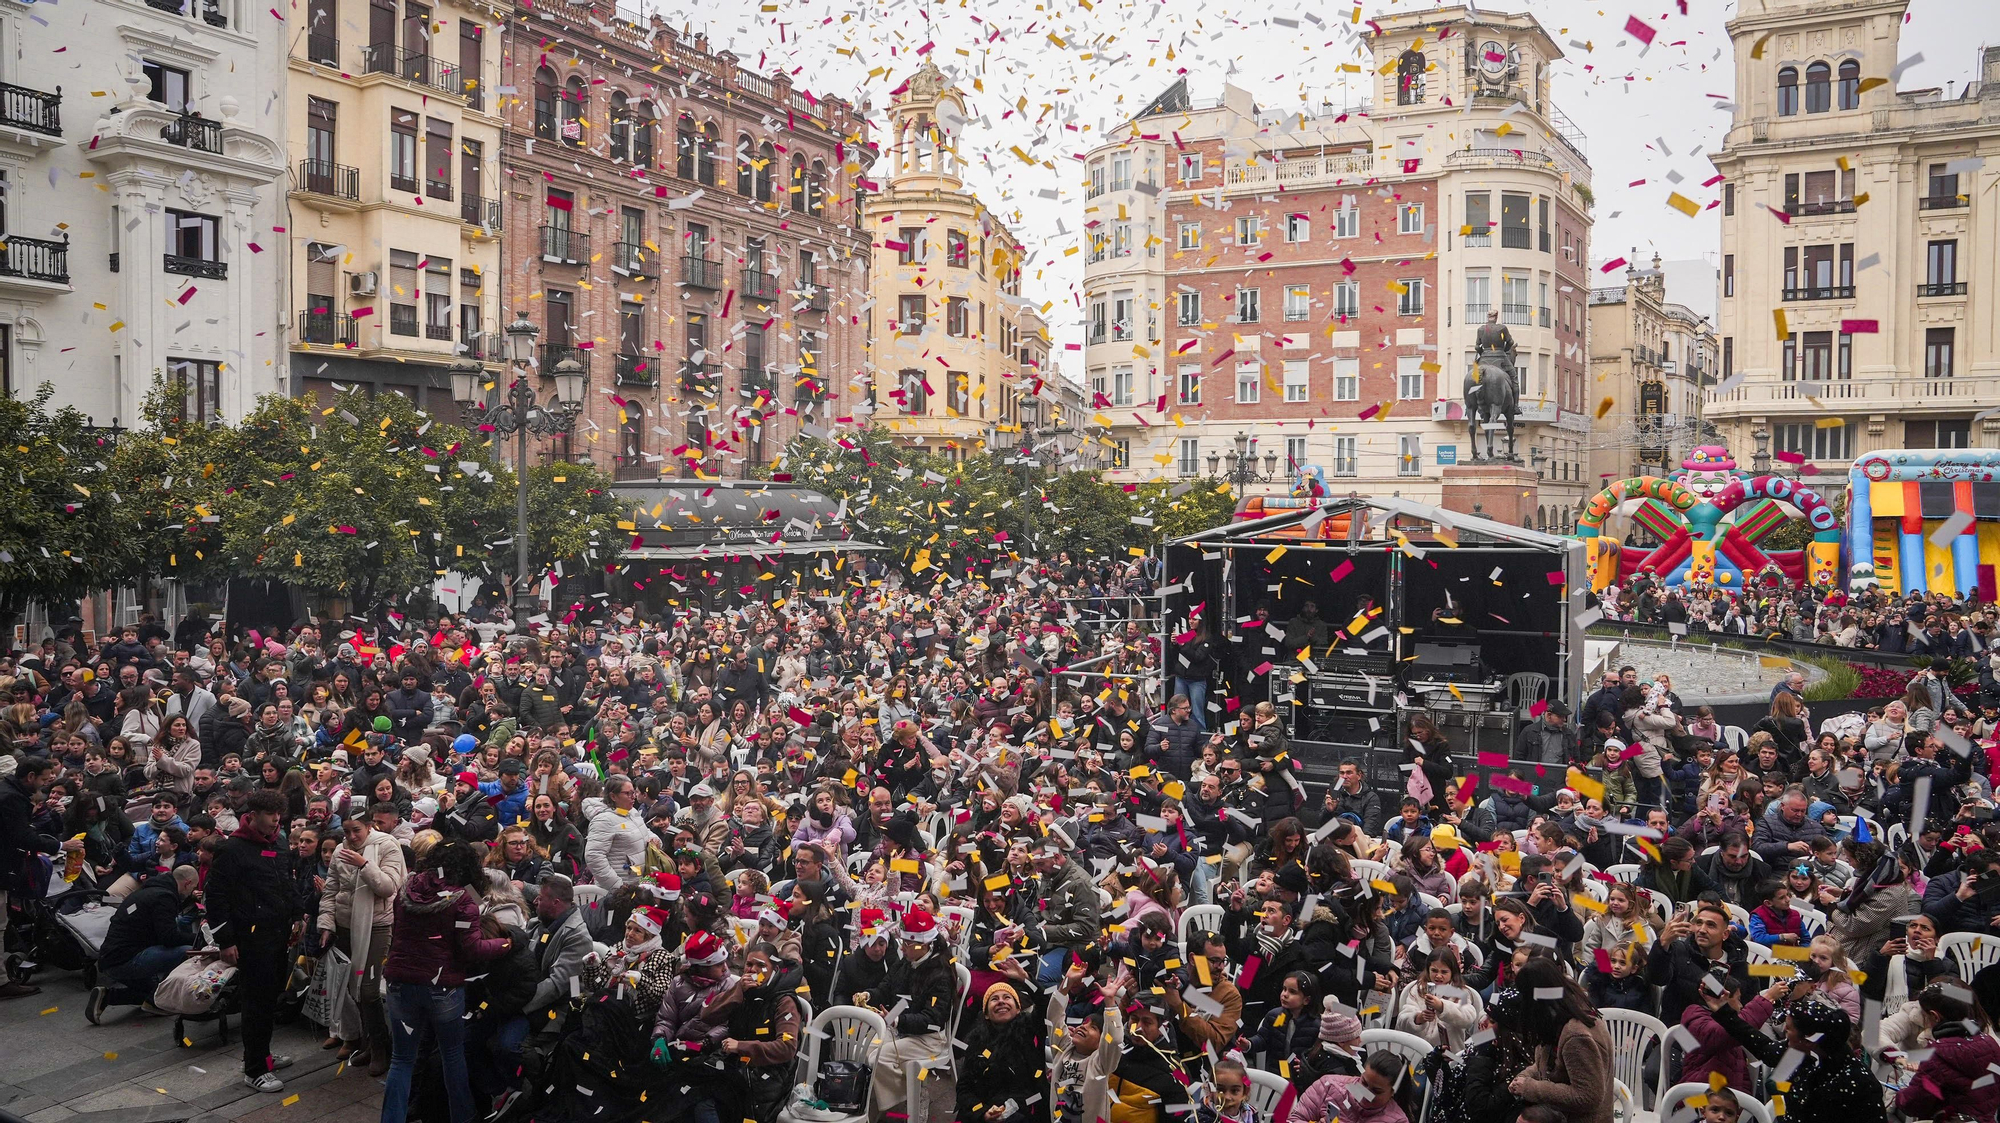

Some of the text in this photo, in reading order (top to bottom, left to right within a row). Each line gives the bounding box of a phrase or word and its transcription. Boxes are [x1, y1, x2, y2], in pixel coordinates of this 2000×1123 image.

[1940, 460, 1969, 469] Merry
[1943, 466, 1984, 474] Christmas
[1584, 477, 1695, 523] CIRCO
[1742, 477, 1835, 529] LOCO
